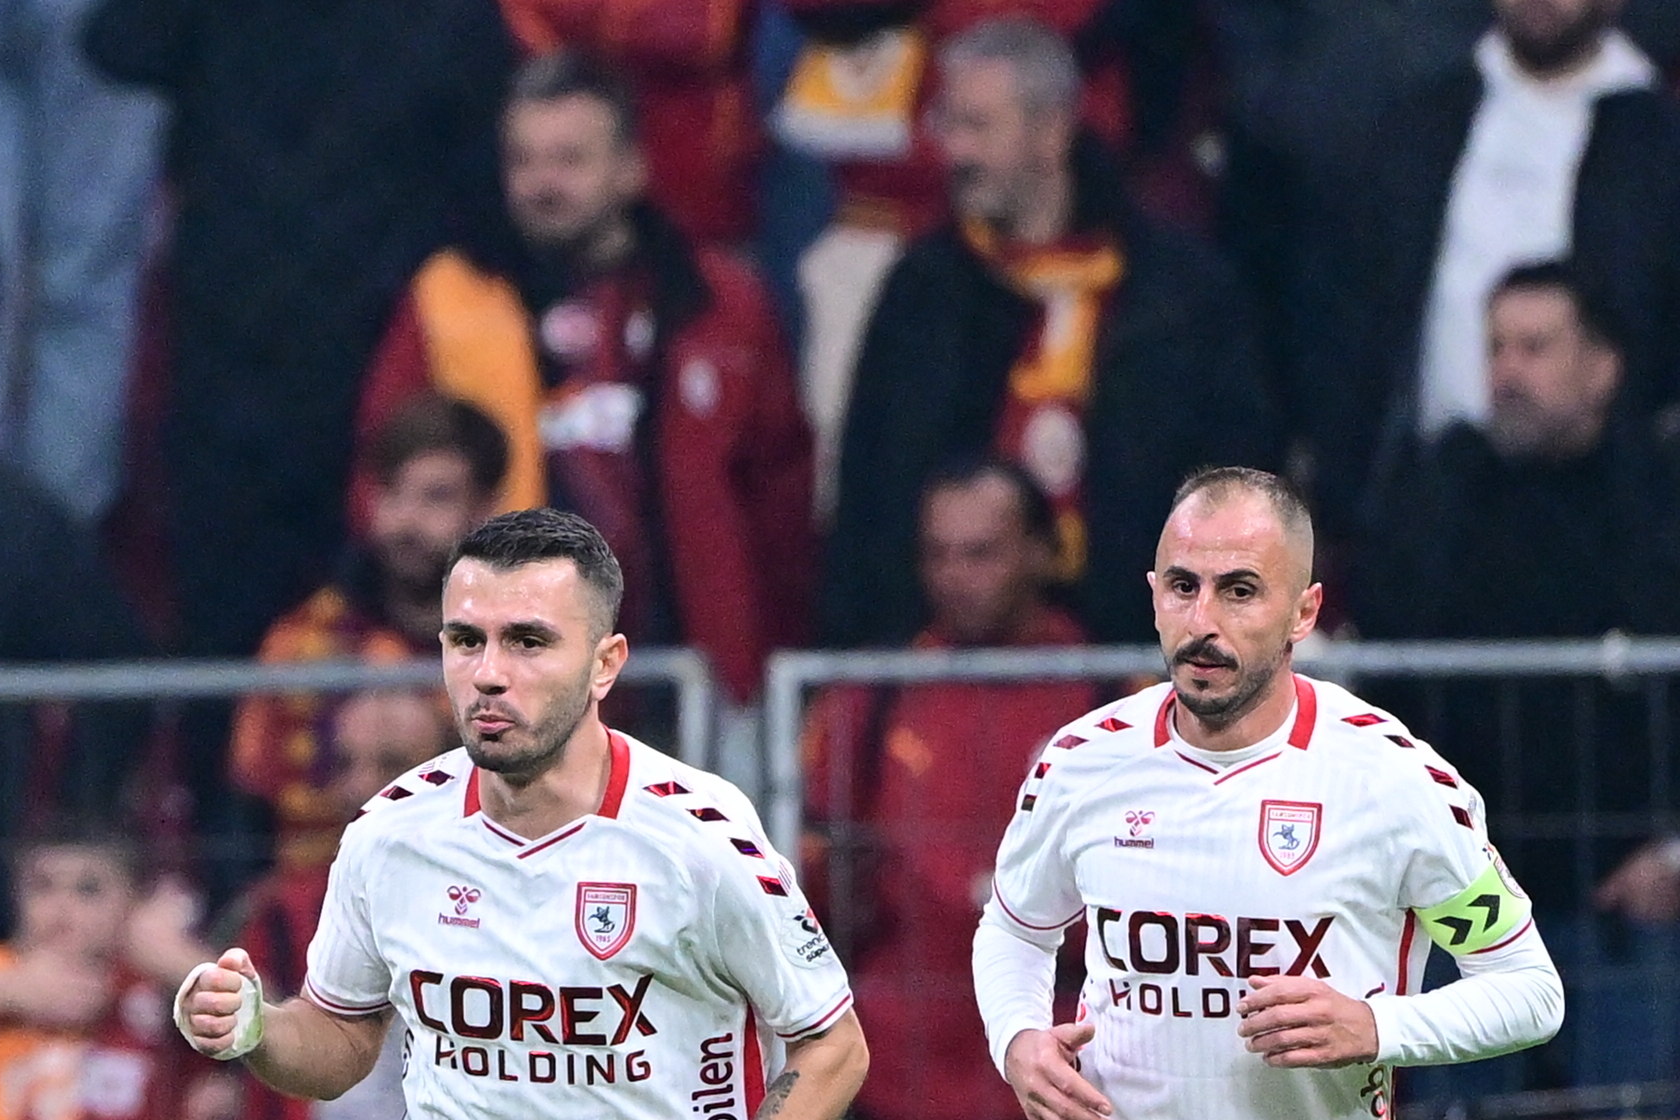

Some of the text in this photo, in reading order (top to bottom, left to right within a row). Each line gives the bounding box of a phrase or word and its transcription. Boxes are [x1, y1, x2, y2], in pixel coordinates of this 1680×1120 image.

[1114, 836, 1155, 849] hummel
[438, 912, 481, 929] hummel
[1096, 907, 1336, 979] COREX
[408, 969, 658, 1047] COREX
[1108, 978, 1249, 1019] HOLDI
[433, 1041, 652, 1087] HOLDING
